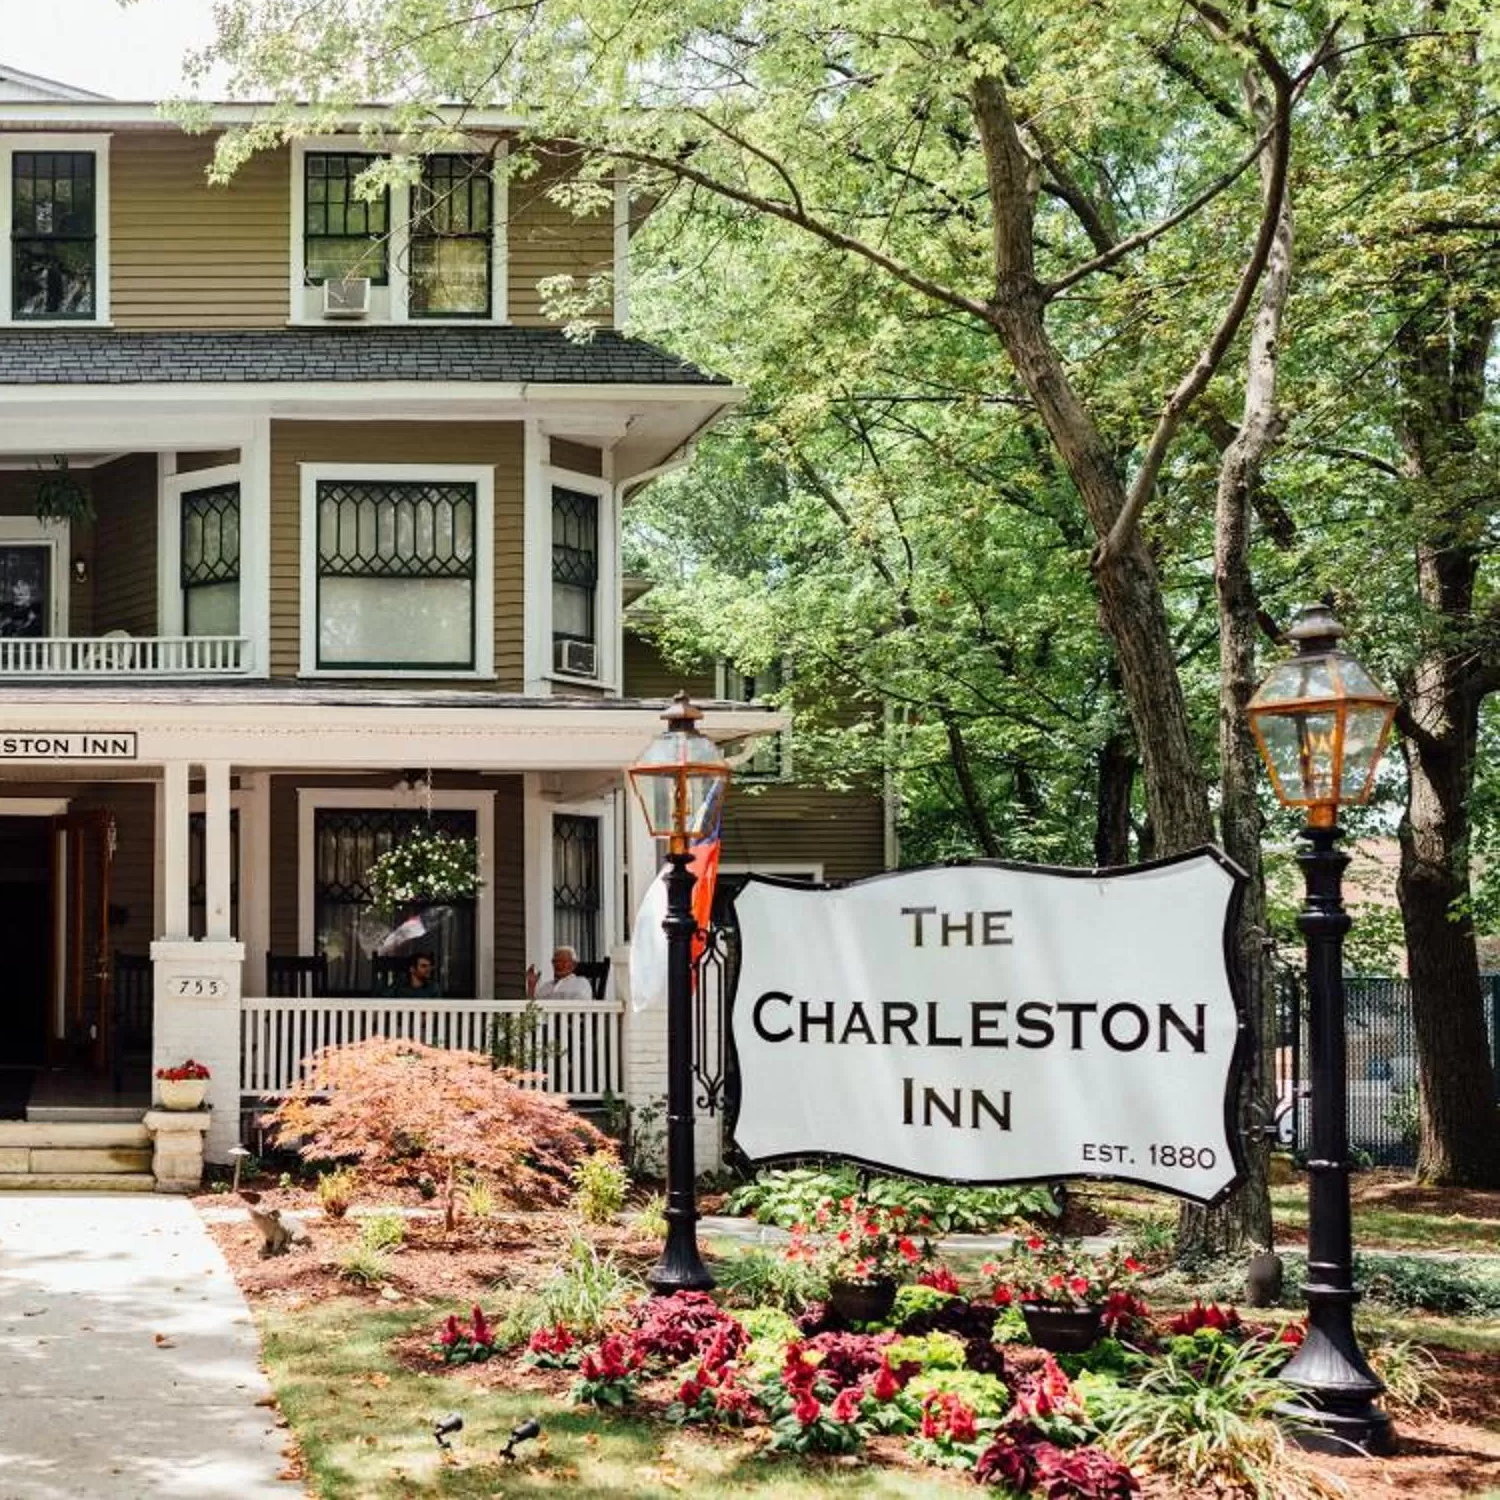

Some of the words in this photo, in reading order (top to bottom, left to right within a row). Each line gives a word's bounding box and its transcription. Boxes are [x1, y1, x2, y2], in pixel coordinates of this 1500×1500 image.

[82, 735, 128, 754] INN
[901, 906, 1013, 947] THE
[179, 980, 218, 995] 755
[752, 991, 1208, 1054] CHARLESTON
[902, 1077, 1012, 1132] INN
[1082, 1143, 1136, 1165] EST.
[1148, 1144, 1217, 1170] 1880
